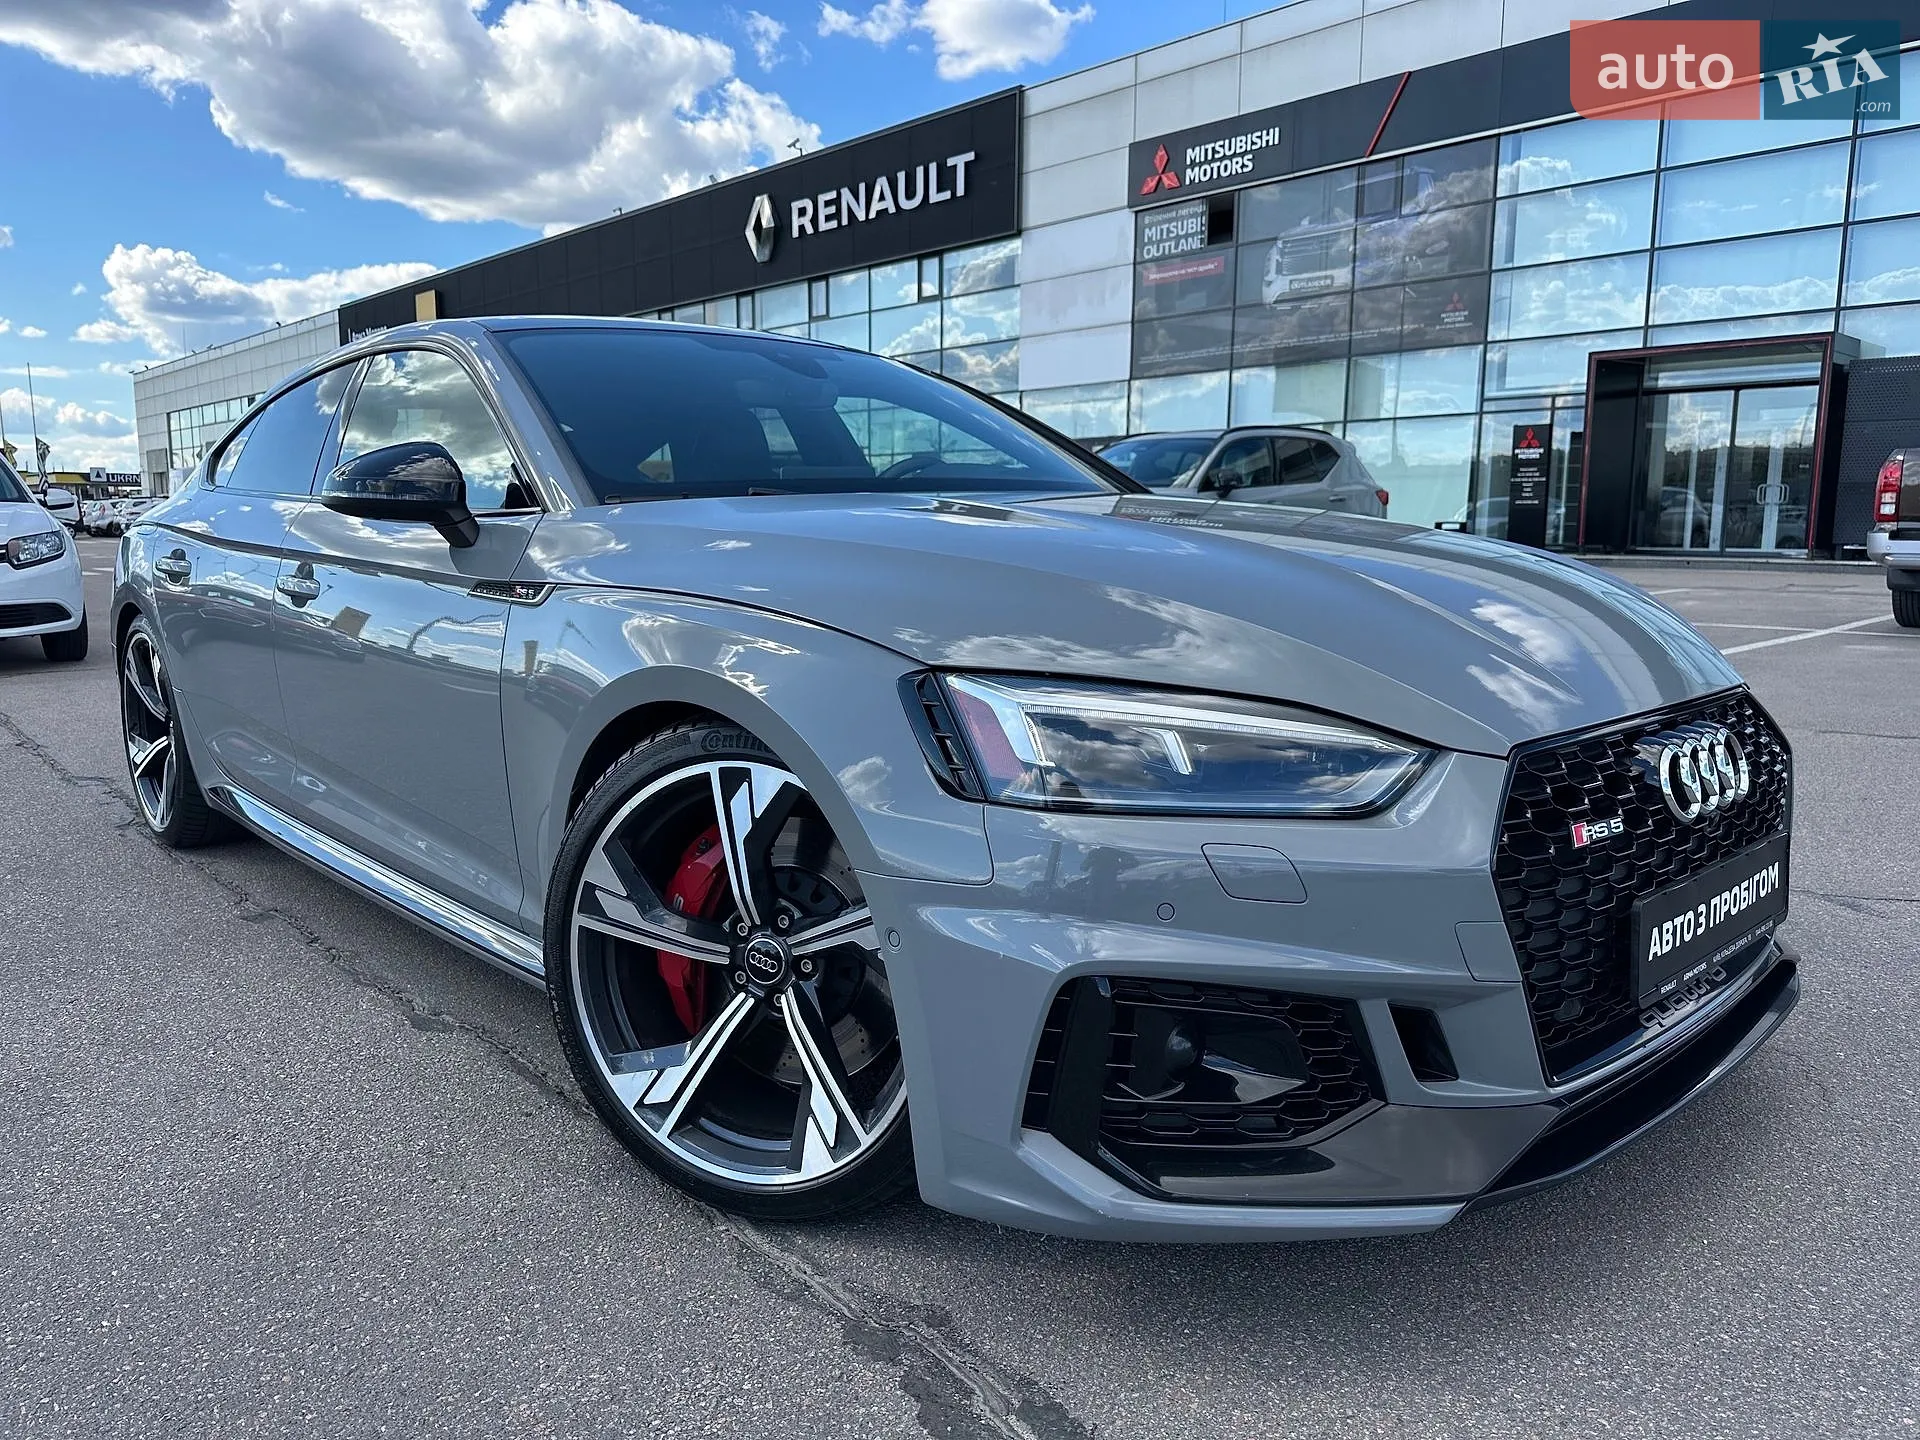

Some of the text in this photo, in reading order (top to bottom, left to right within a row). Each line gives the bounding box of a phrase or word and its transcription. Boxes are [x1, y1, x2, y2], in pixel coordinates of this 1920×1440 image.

[1185, 126, 1280, 165] MITSUBISHI
[1185, 154, 1254, 186] MOTORS
[790, 150, 976, 239] RENAULT
[1648, 910, 1695, 962] АВТО
[1709, 861, 1780, 929] ПРОБІГОМ
